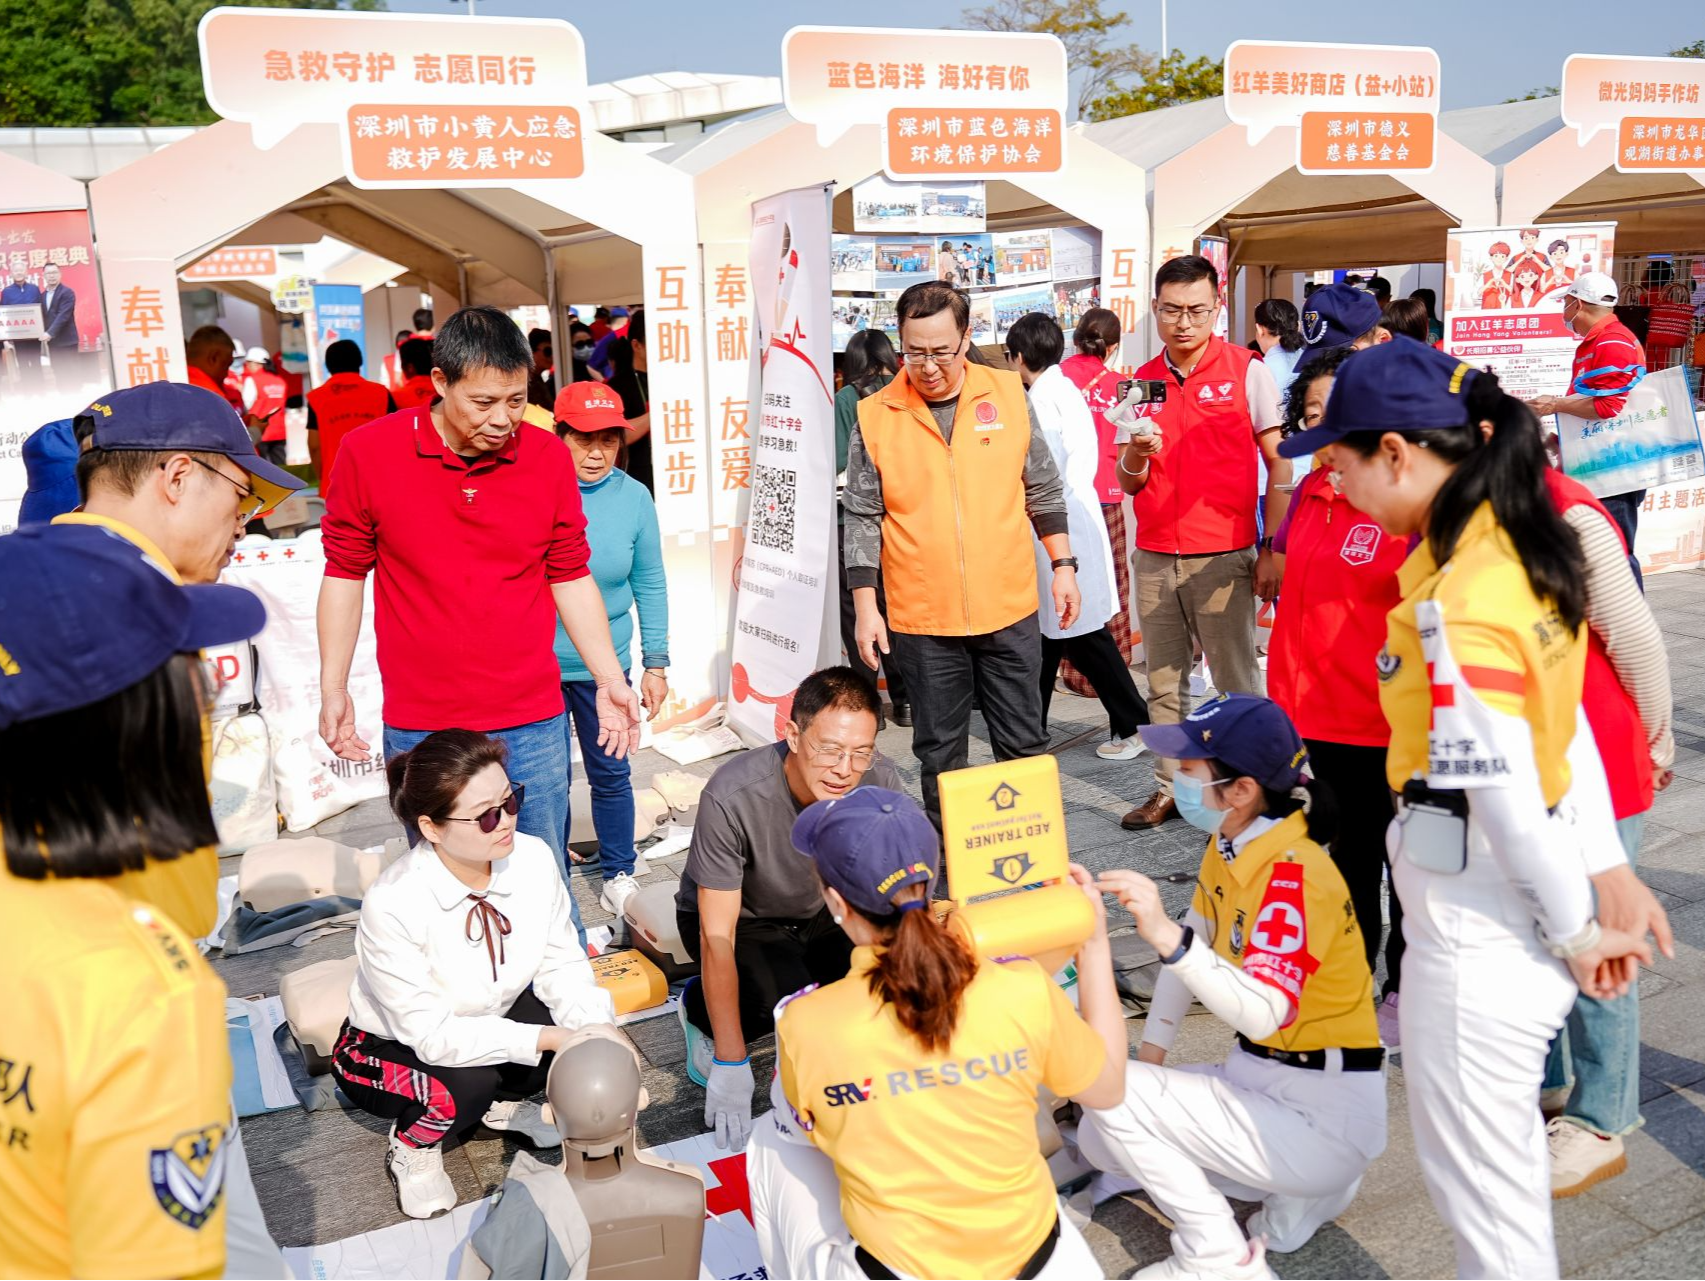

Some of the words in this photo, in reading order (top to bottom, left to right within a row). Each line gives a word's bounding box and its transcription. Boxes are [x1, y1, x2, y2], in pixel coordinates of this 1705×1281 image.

[263, 49, 396, 83] 急救守护
[413, 53, 537, 86] 志愿同行
[827, 61, 926, 90] 蓝色海洋
[938, 63, 1030, 91] 海好有你
[1598, 81, 1700, 104] 微光妈妈手作坊
[353, 114, 577, 139] 深圳市小黄人应急
[897, 116, 1053, 138] 深圳市蓝色海洋
[1326, 119, 1411, 138] 深圳市德义
[1632, 124, 1705, 140] 深圳市龙华
[386, 146, 554, 171] 救护发展中心
[910, 143, 1043, 165] 环境保护协会
[1325, 143, 1411, 162] 慈善基金会
[1109, 249, 1137, 334] 互助
[655, 266, 691, 364] 互助
[715, 263, 749, 362] 奉献
[1456, 317, 1540, 332] 加入红羊志愿团
[120, 286, 170, 388] 奉献
[661, 399, 696, 496] 进步
[720, 396, 751, 491] 友爱
[1428, 758, 1512, 776] 愿服务队
[965, 829, 1023, 850] TRAINER
[1026, 821, 1050, 837] AED
[885, 1047, 1029, 1097] RESCUE
